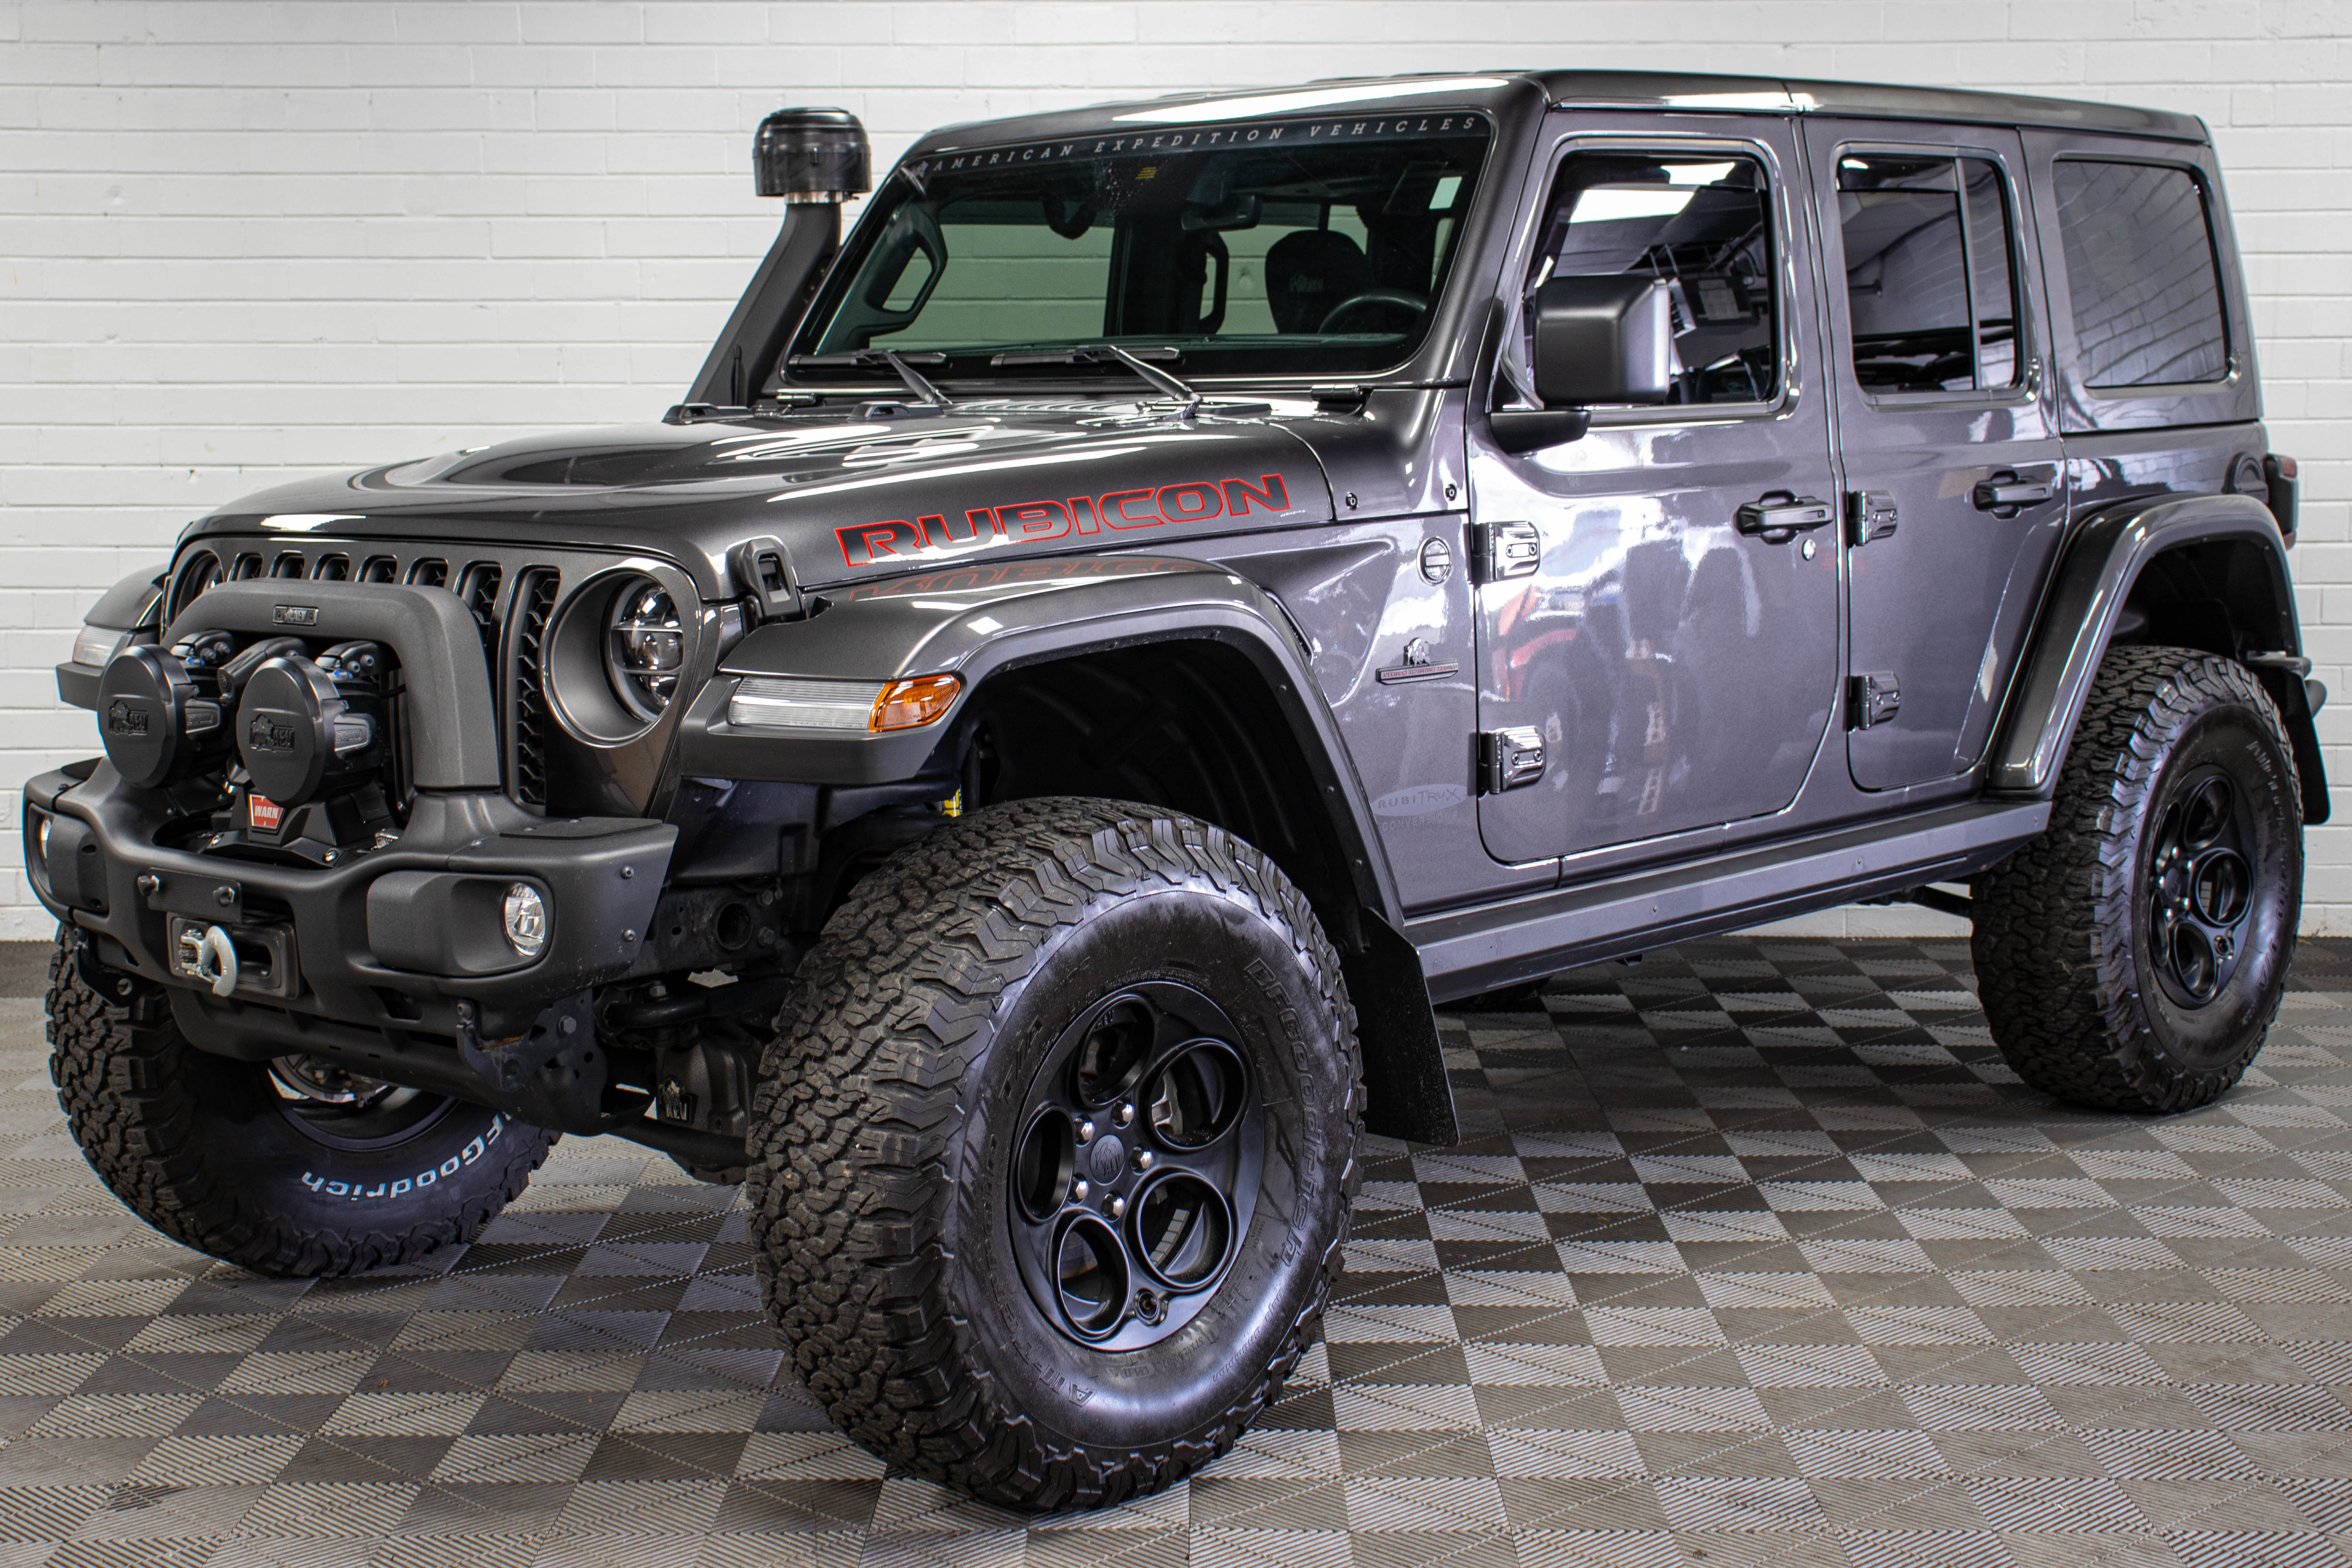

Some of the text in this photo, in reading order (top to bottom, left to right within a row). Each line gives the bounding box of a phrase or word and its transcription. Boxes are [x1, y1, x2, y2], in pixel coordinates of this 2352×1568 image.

[933, 117, 1475, 171] AMERICAN EXPEDITION VEHICLES
[834, 474, 1290, 567] RUBICON
[254, 805, 279, 819] WARN
[301, 1110, 513, 1201] FGoodrich
[1244, 958, 1322, 1267] BFGoodrich
